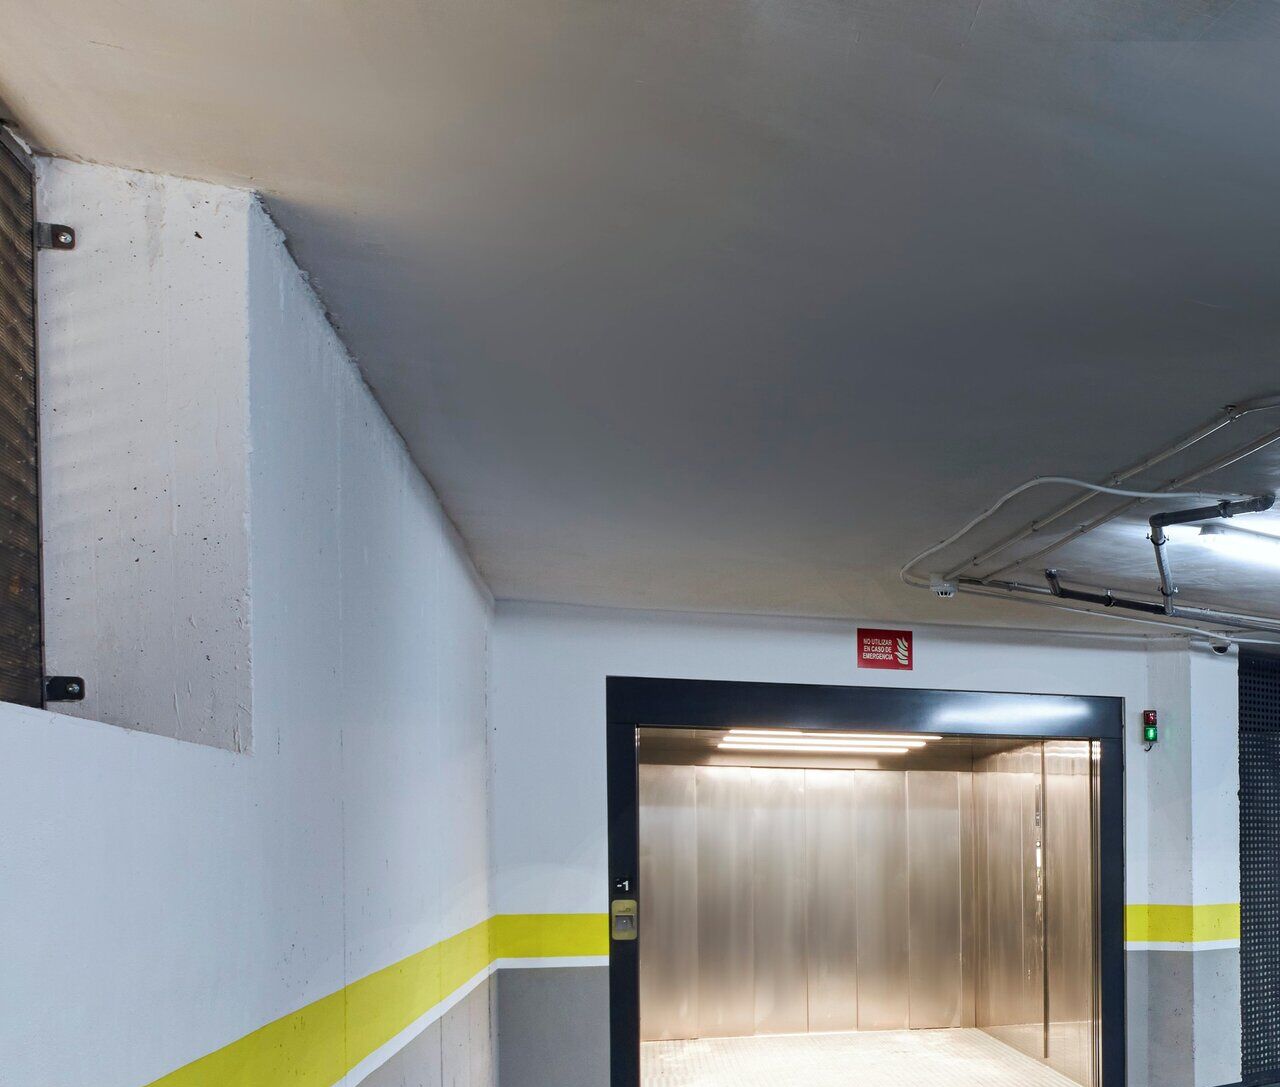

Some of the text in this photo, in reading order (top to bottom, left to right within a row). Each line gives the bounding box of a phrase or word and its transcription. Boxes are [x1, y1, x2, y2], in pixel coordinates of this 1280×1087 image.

[885, 646, 892, 654] DE
[863, 652, 894, 660] EMERGENCIA
[616, 880, 630, 891] -1
